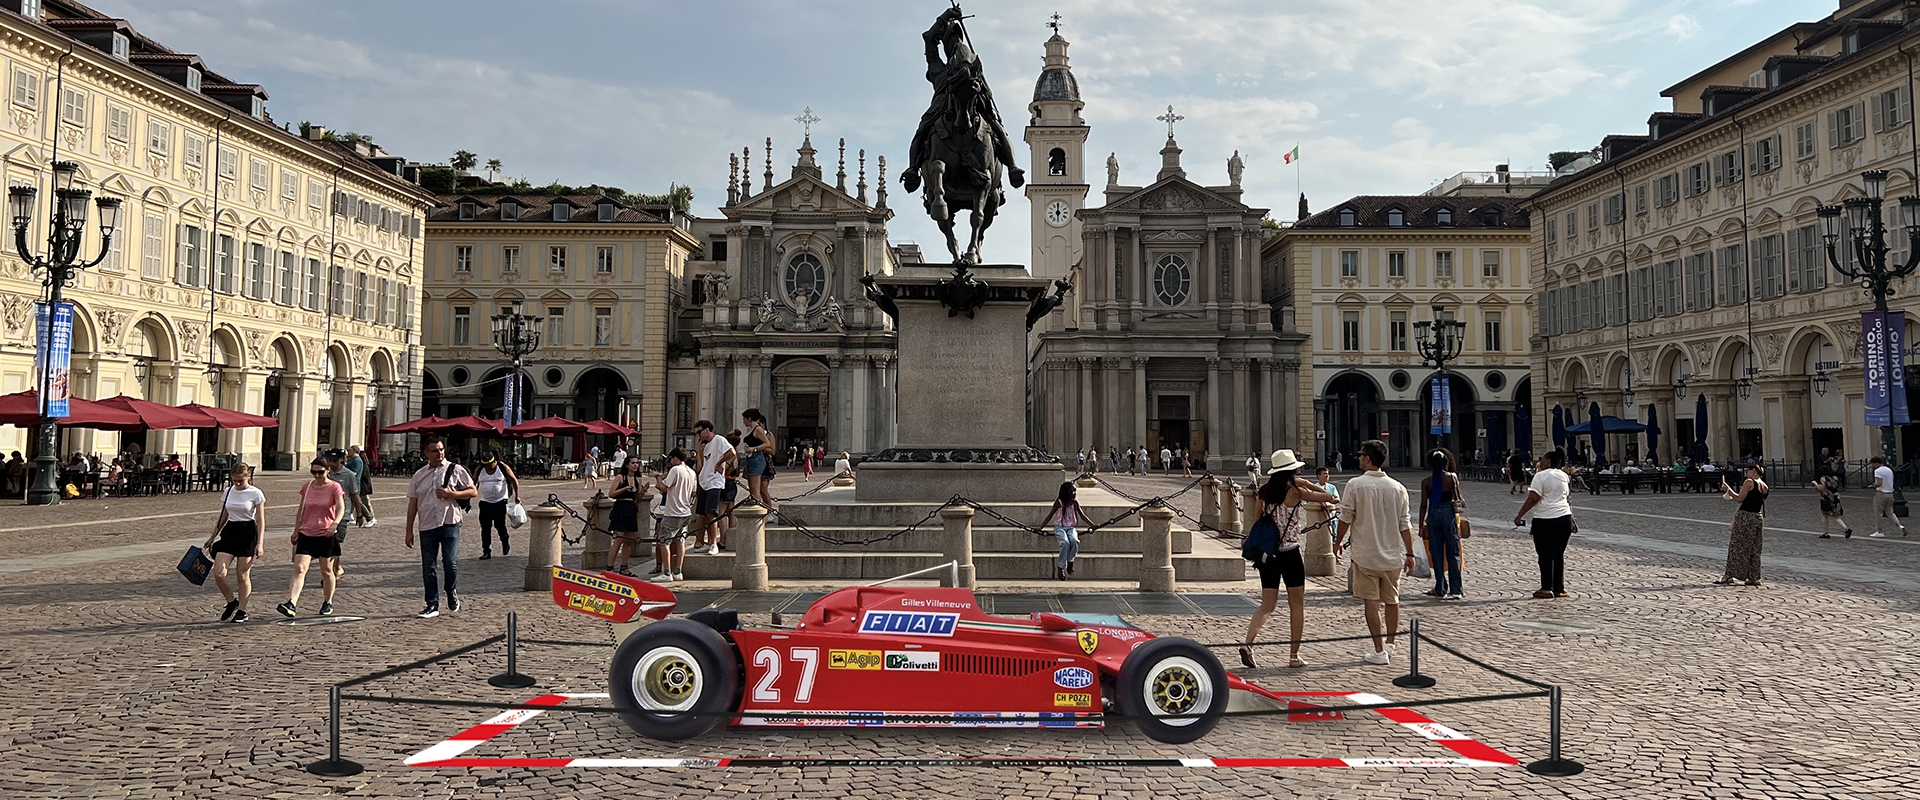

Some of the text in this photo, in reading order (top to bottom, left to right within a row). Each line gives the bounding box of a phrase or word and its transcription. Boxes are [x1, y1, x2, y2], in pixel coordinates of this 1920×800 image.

[1866, 327, 1878, 389] TORINO,
[557, 570, 633, 596] MICHELIN
[584, 596, 614, 613] Agip
[901, 598, 972, 609] Gilles Villeneuve
[869, 615, 951, 632] FIAT
[1098, 628, 1146, 638] LONGINES
[846, 651, 881, 668] Agip
[902, 661, 938, 670] olivetti
[752, 645, 820, 703] 27
[1055, 668, 1093, 684] MAGNETI
[1056, 693, 1090, 702] CH POZZI
